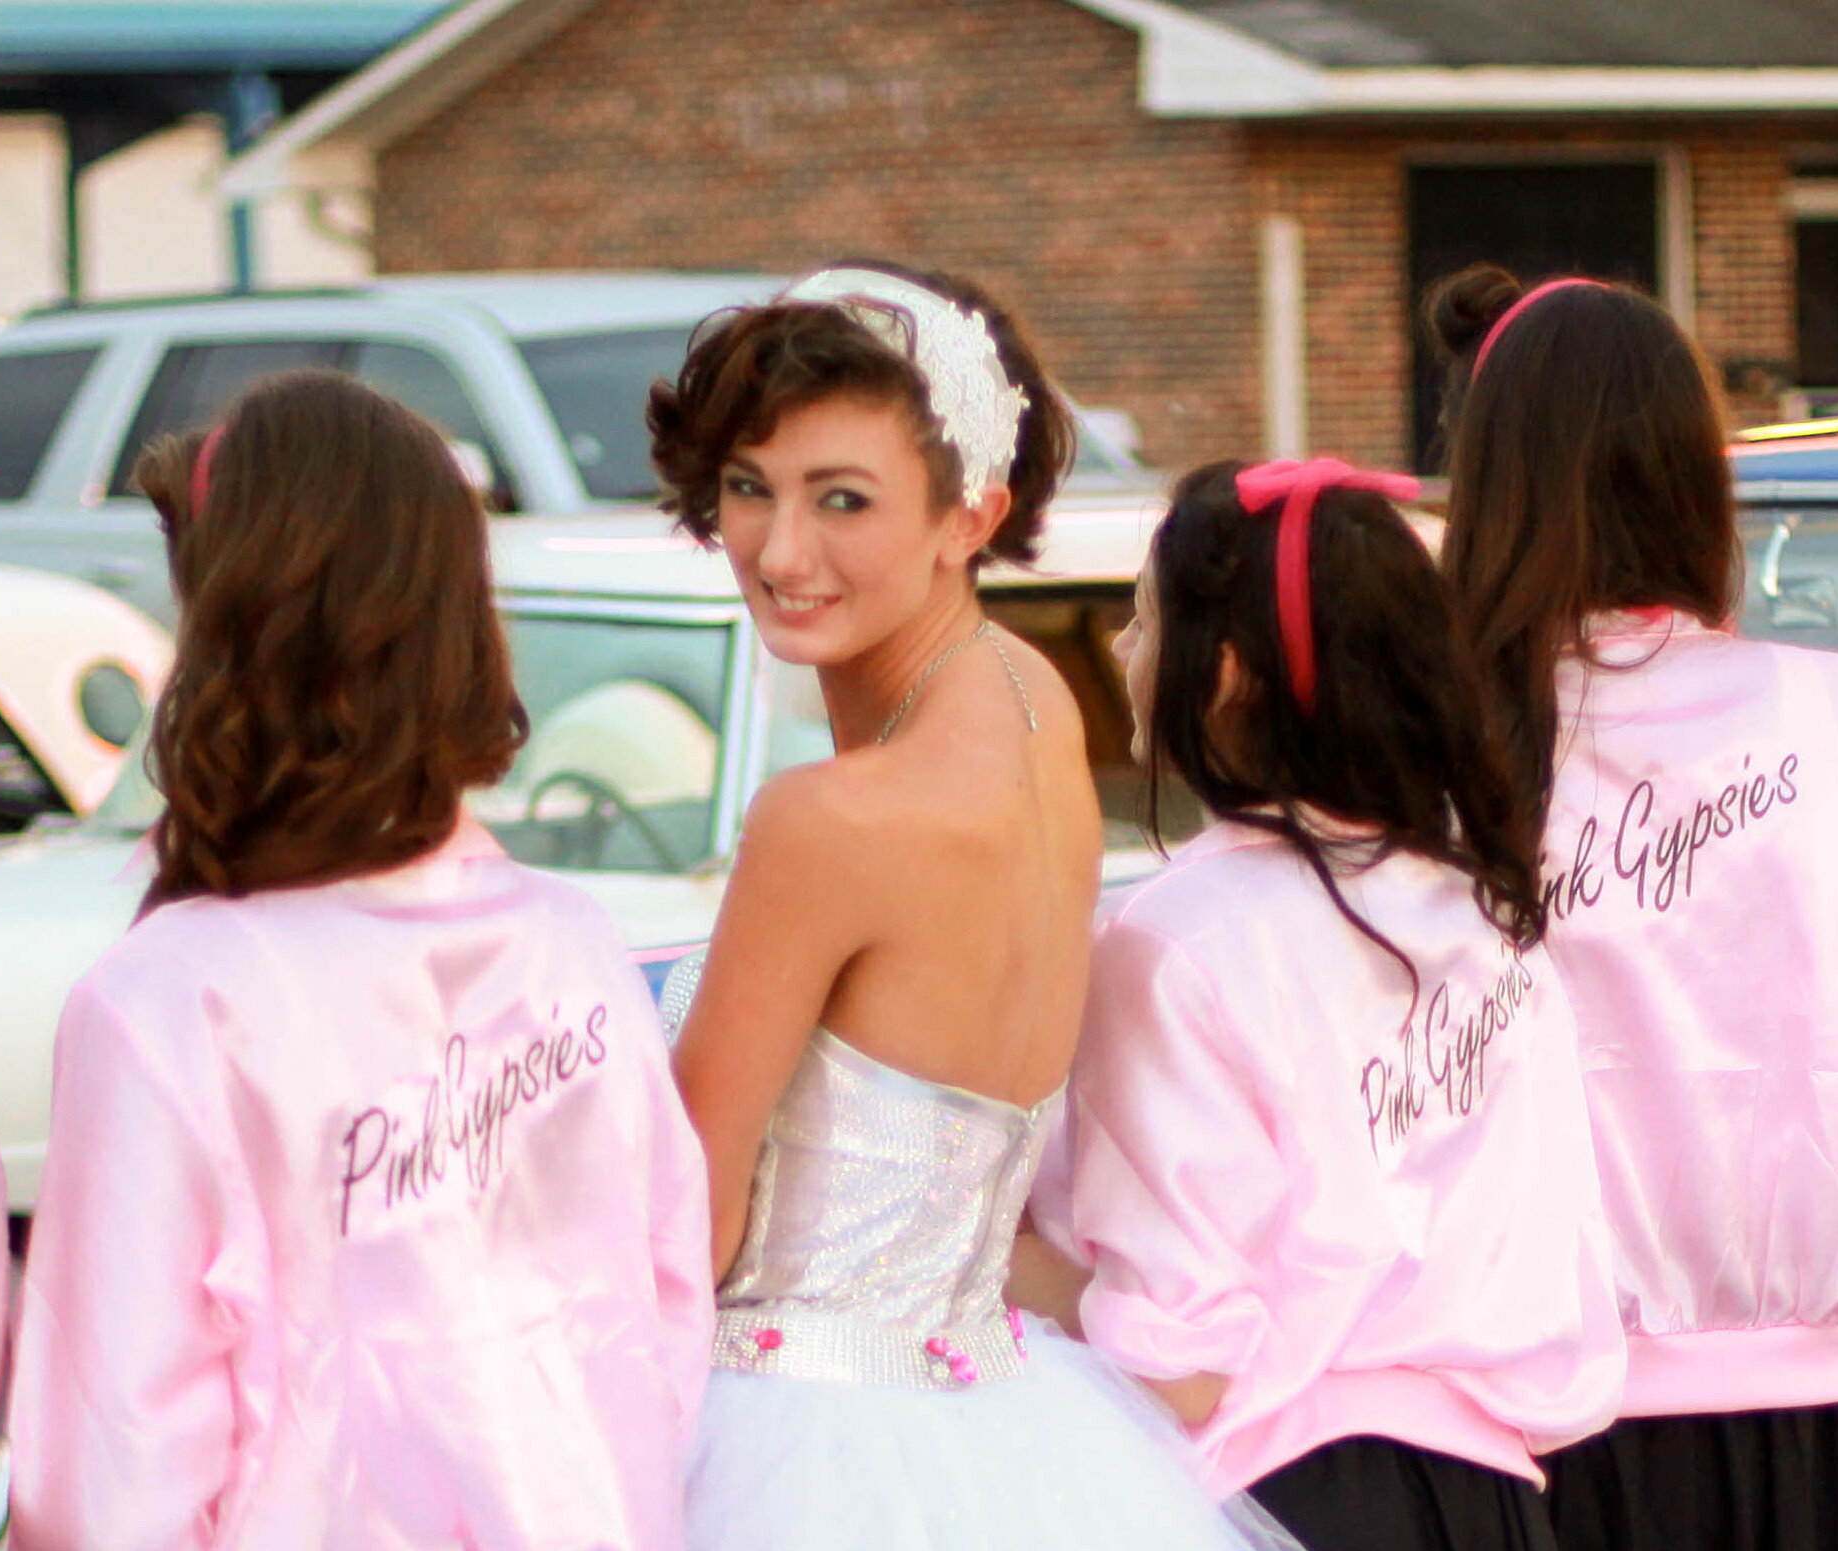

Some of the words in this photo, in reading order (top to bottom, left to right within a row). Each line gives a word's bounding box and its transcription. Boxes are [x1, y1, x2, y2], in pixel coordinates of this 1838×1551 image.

[1614, 753, 1799, 913] Gypsies
[341, 1075, 446, 1238] Pink
[446, 1003, 608, 1190] Gypsies
[1360, 1022, 1426, 1160] Pink
[1425, 938, 1533, 1117] Gypsies
